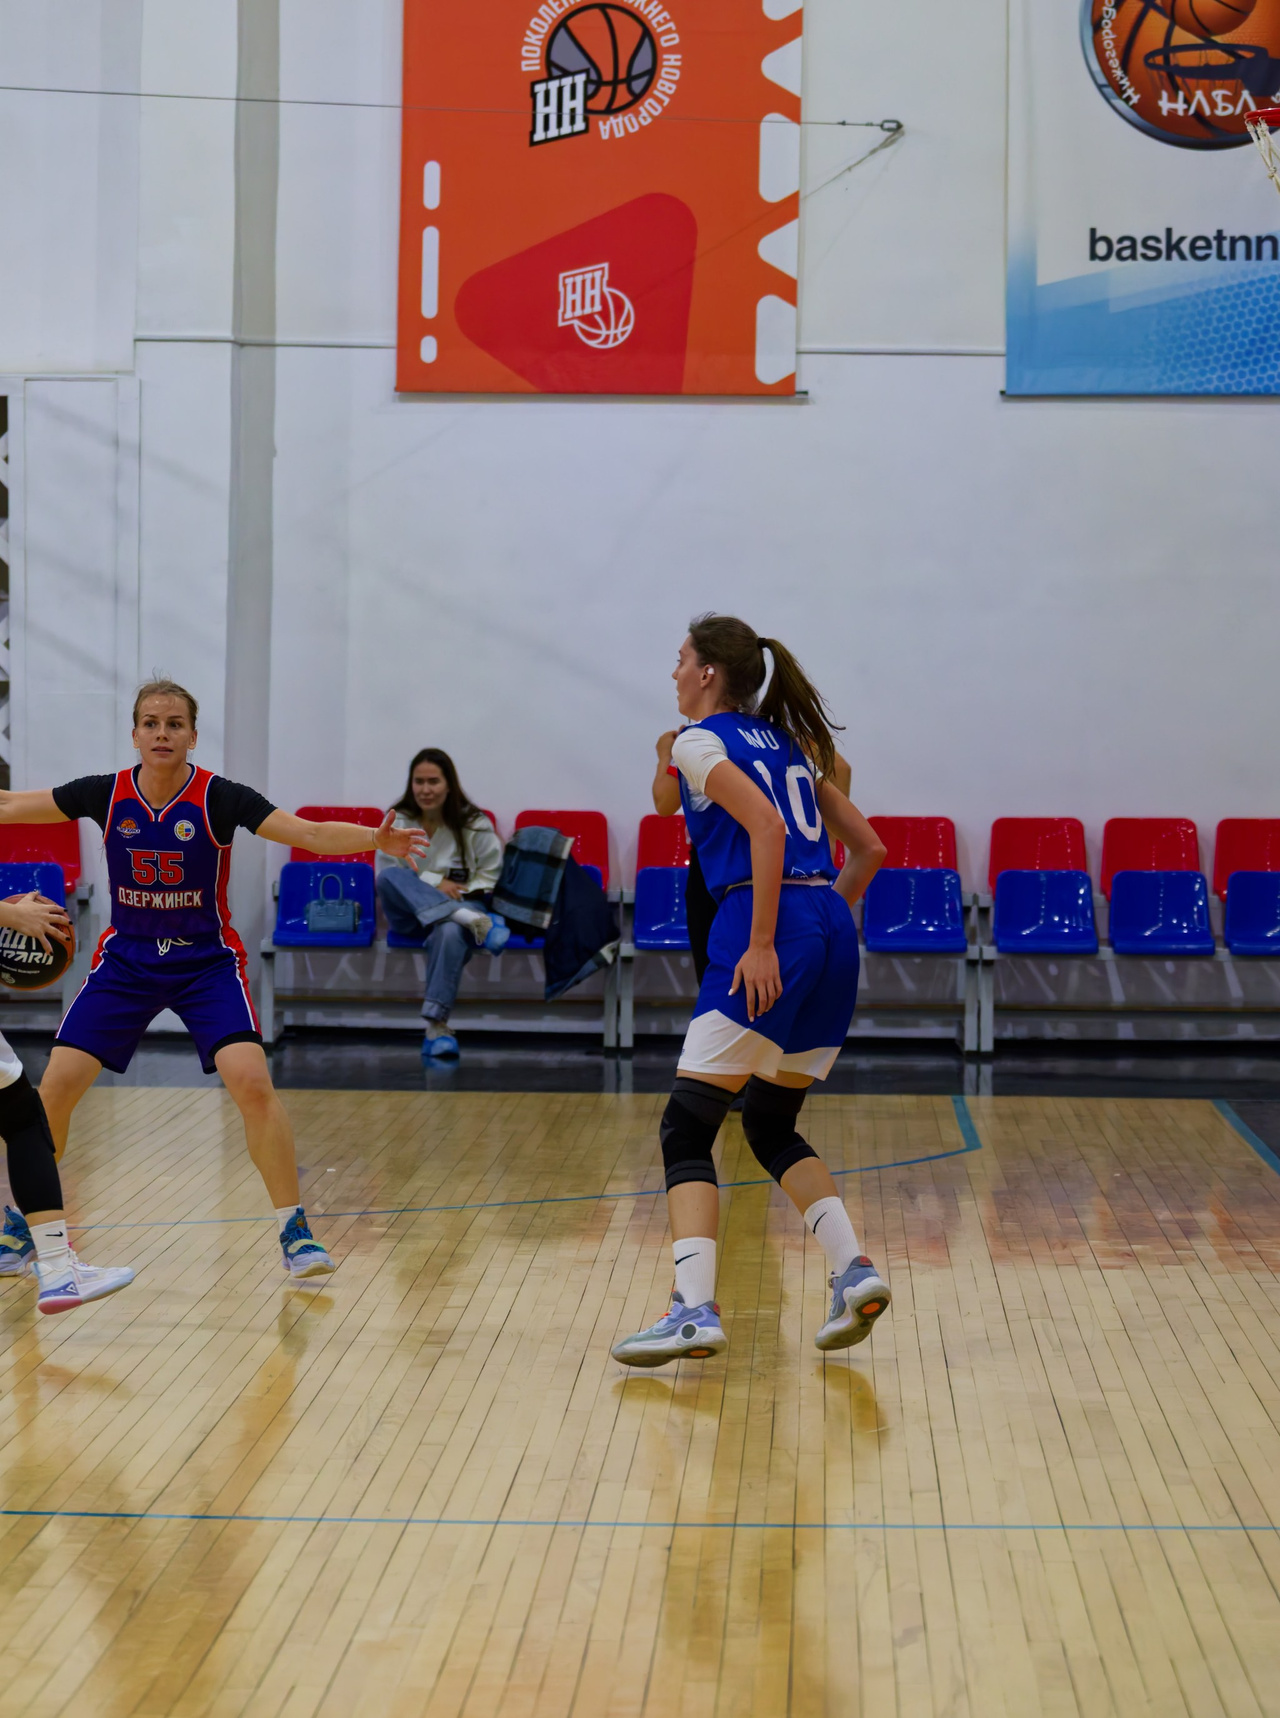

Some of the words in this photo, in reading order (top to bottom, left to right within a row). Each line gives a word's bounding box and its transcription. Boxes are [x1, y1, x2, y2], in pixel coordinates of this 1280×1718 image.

[598, 54, 682, 140] НОВГОРОДА
[1089, 227, 1279, 261] basketnn
[753, 759, 822, 843] 10
[125, 848, 184, 885] 55
[118, 886, 202, 909] ДЗЕРЖИНСК
